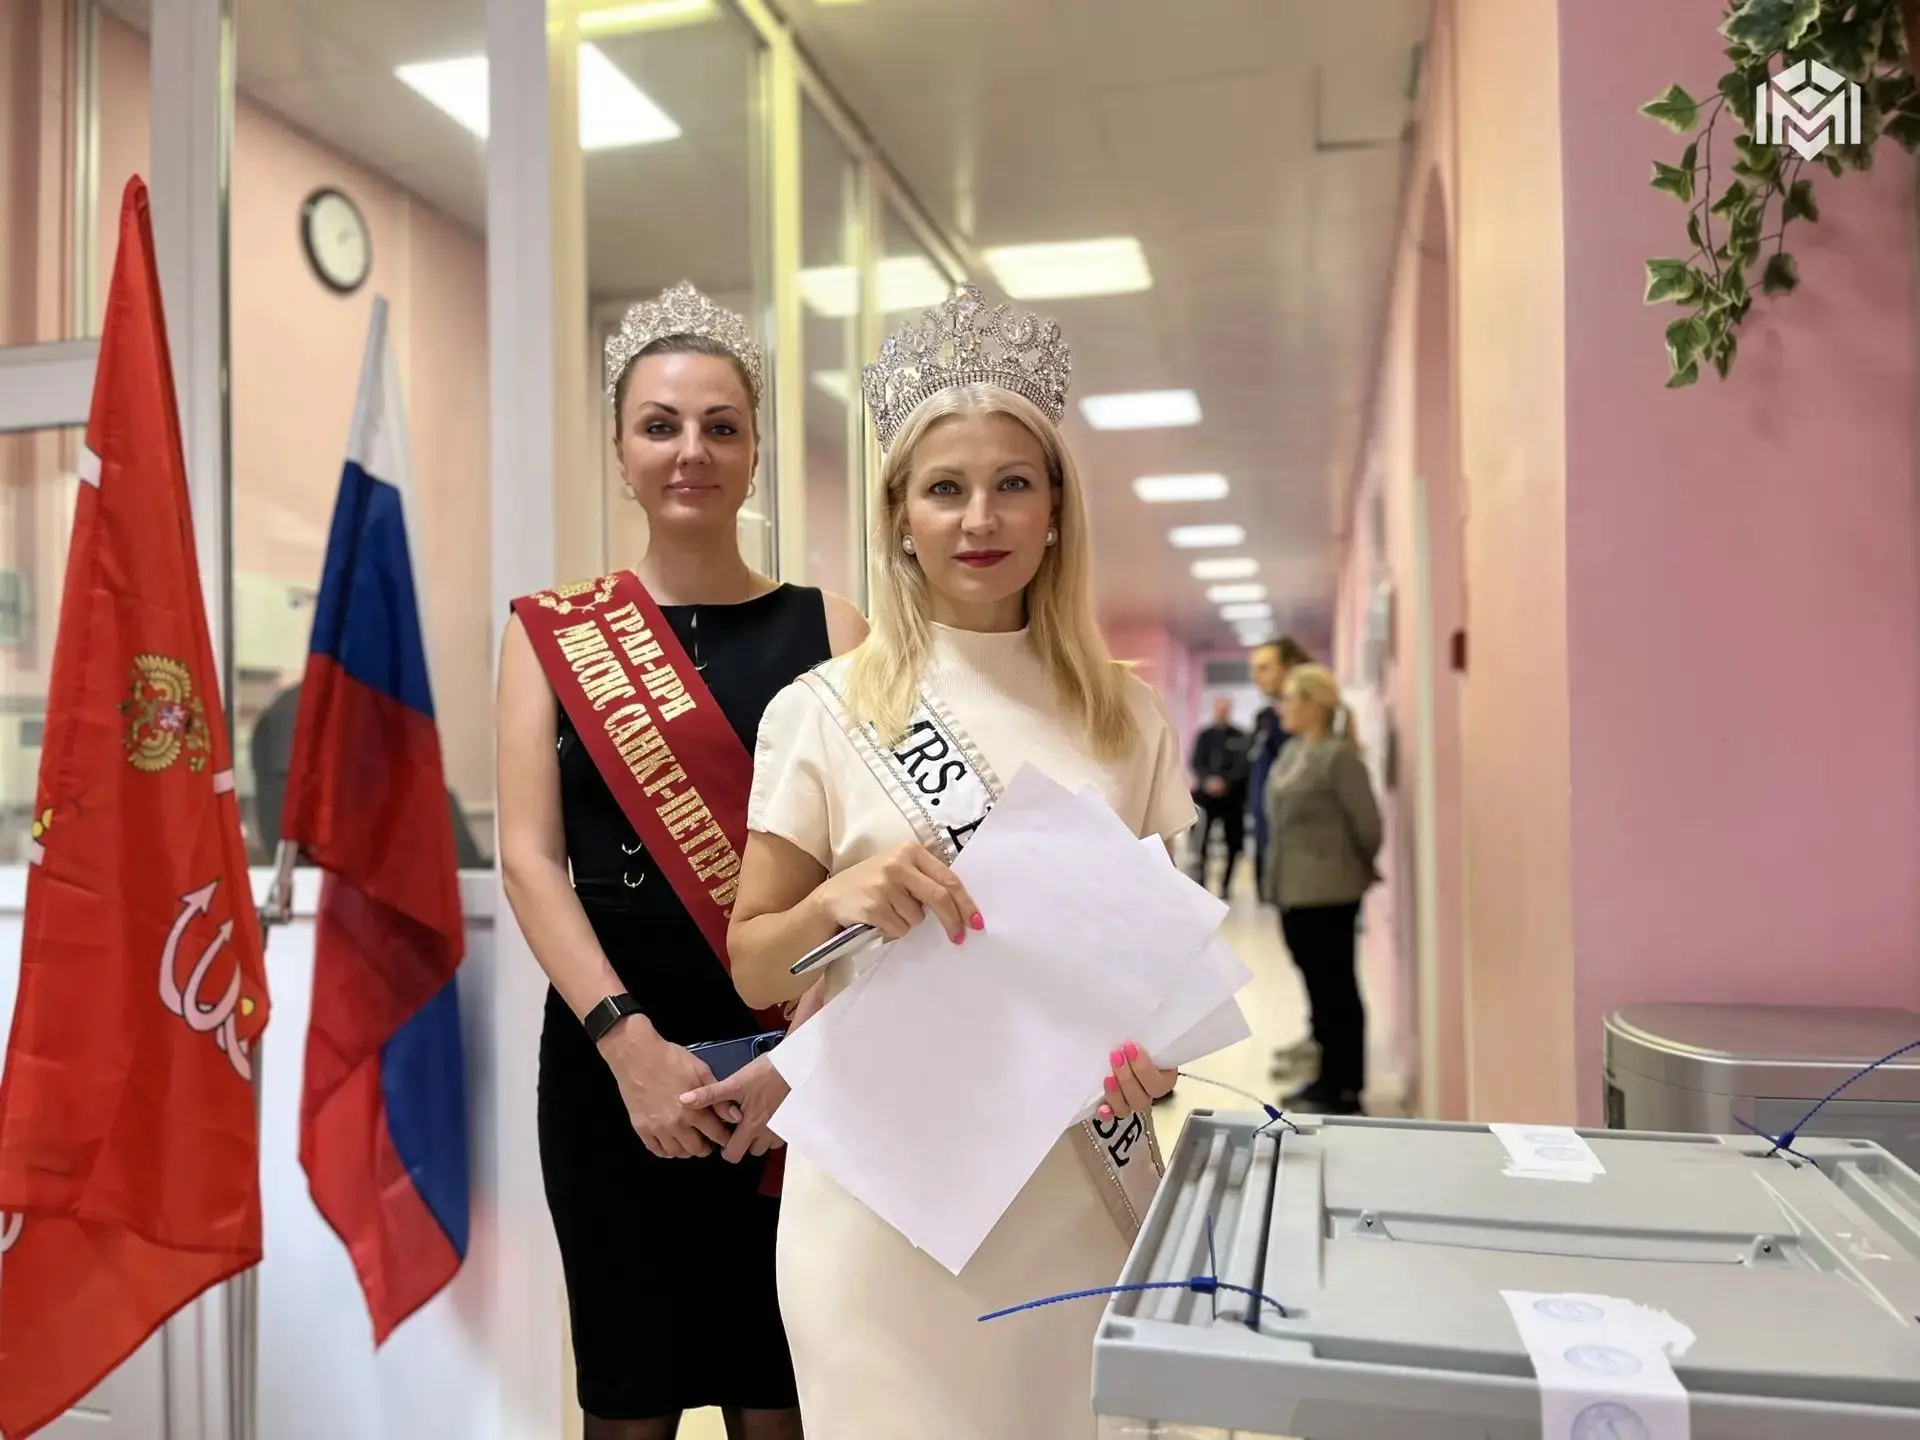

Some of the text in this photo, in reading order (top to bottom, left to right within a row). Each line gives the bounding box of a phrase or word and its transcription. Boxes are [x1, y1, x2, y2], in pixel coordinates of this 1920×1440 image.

[603, 601, 697, 722] ГРАН-ПРИ
[553, 619, 742, 919] МИССИС САНКТ-ПЕТЕРБ
